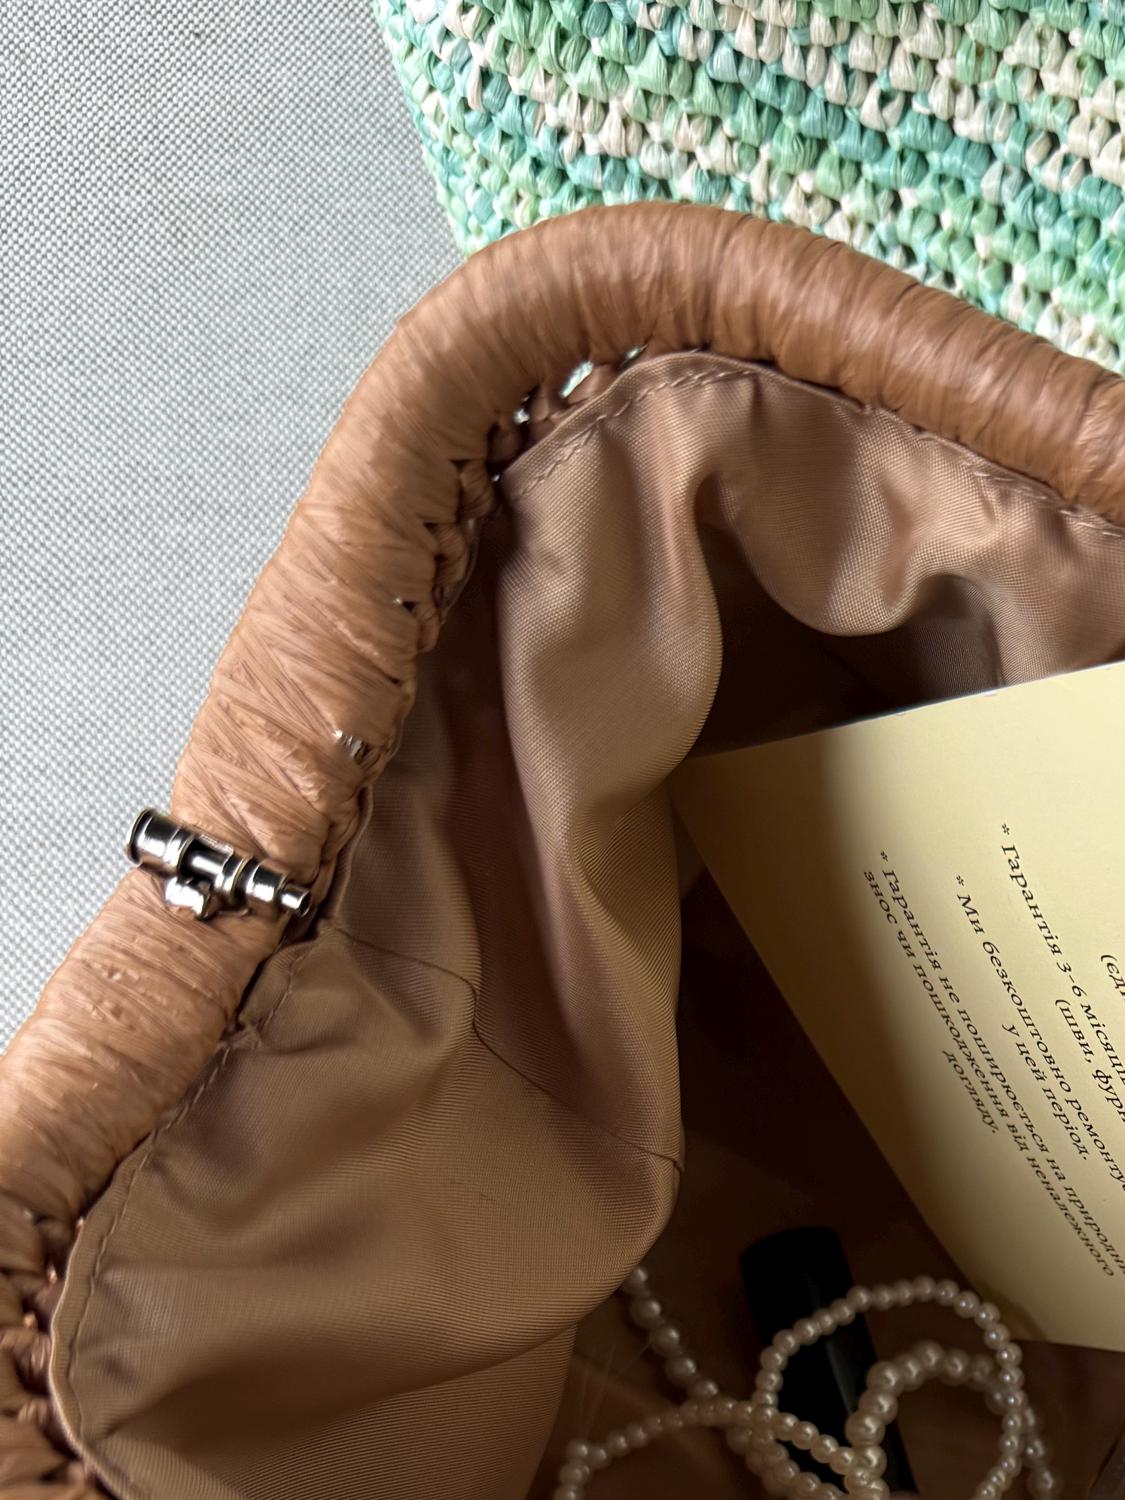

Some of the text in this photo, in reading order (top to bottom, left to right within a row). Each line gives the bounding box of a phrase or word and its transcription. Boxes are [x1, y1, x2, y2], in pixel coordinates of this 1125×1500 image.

[957, 894, 985, 935] Ми
[982, 941, 1072, 1093] безкоштовно
[1001, 844, 1063, 956] Гарантія
[1056, 962, 1088, 997] 3-6
[864, 871, 1115, 1277] знос чи пошкодження від неналежного
[882, 869, 942, 970] Гарантія
[939, 976, 960, 1003] не
[958, 1008, 1050, 1152] поширюється
[1046, 1157, 1066, 1181] на
[942, 1050, 999, 1134] догляду.
[1002, 1023, 1090, 1160] у цей період.
[1055, 999, 1095, 1064] (шви,
